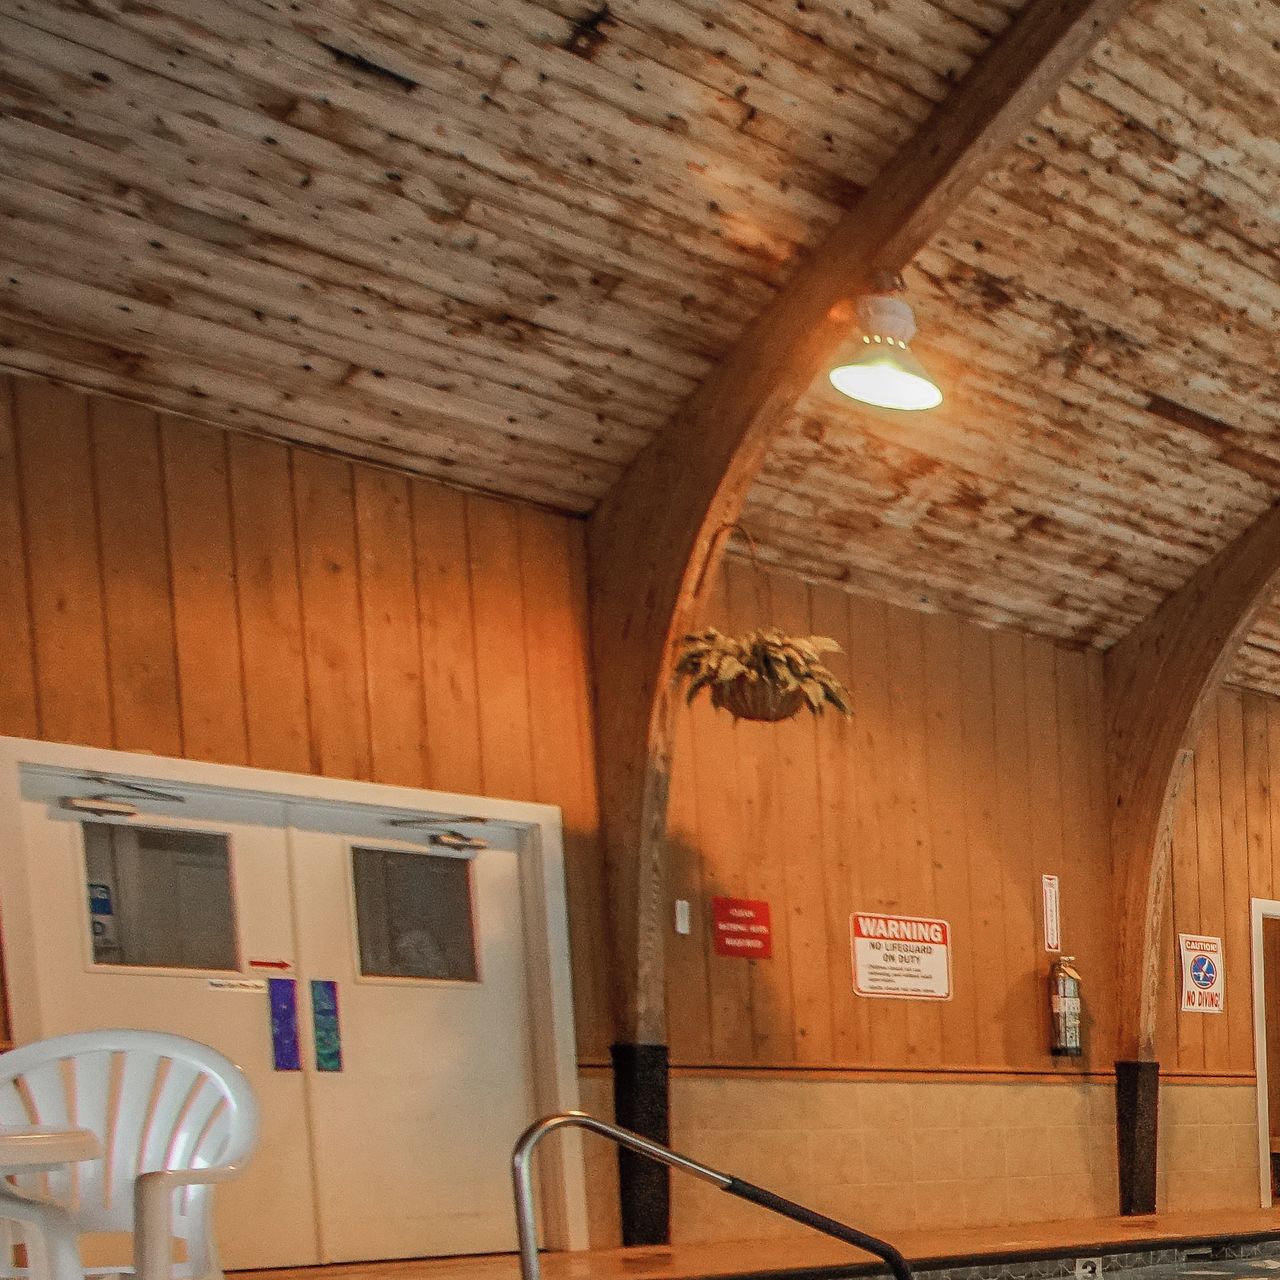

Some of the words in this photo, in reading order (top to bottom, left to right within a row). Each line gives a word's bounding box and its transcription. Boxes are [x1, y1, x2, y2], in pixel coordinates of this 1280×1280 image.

[857, 916, 944, 943] WARNING
[868, 941, 882, 951] NO
[884, 942, 933, 955] LIFEGUARD
[1185, 940, 1217, 952] CAUTION!
[882, 953, 896, 962] ON
[898, 954, 920, 964] DUTY
[1186, 990, 1196, 1007] NO
[1198, 991, 1220, 1008] DIVING!
